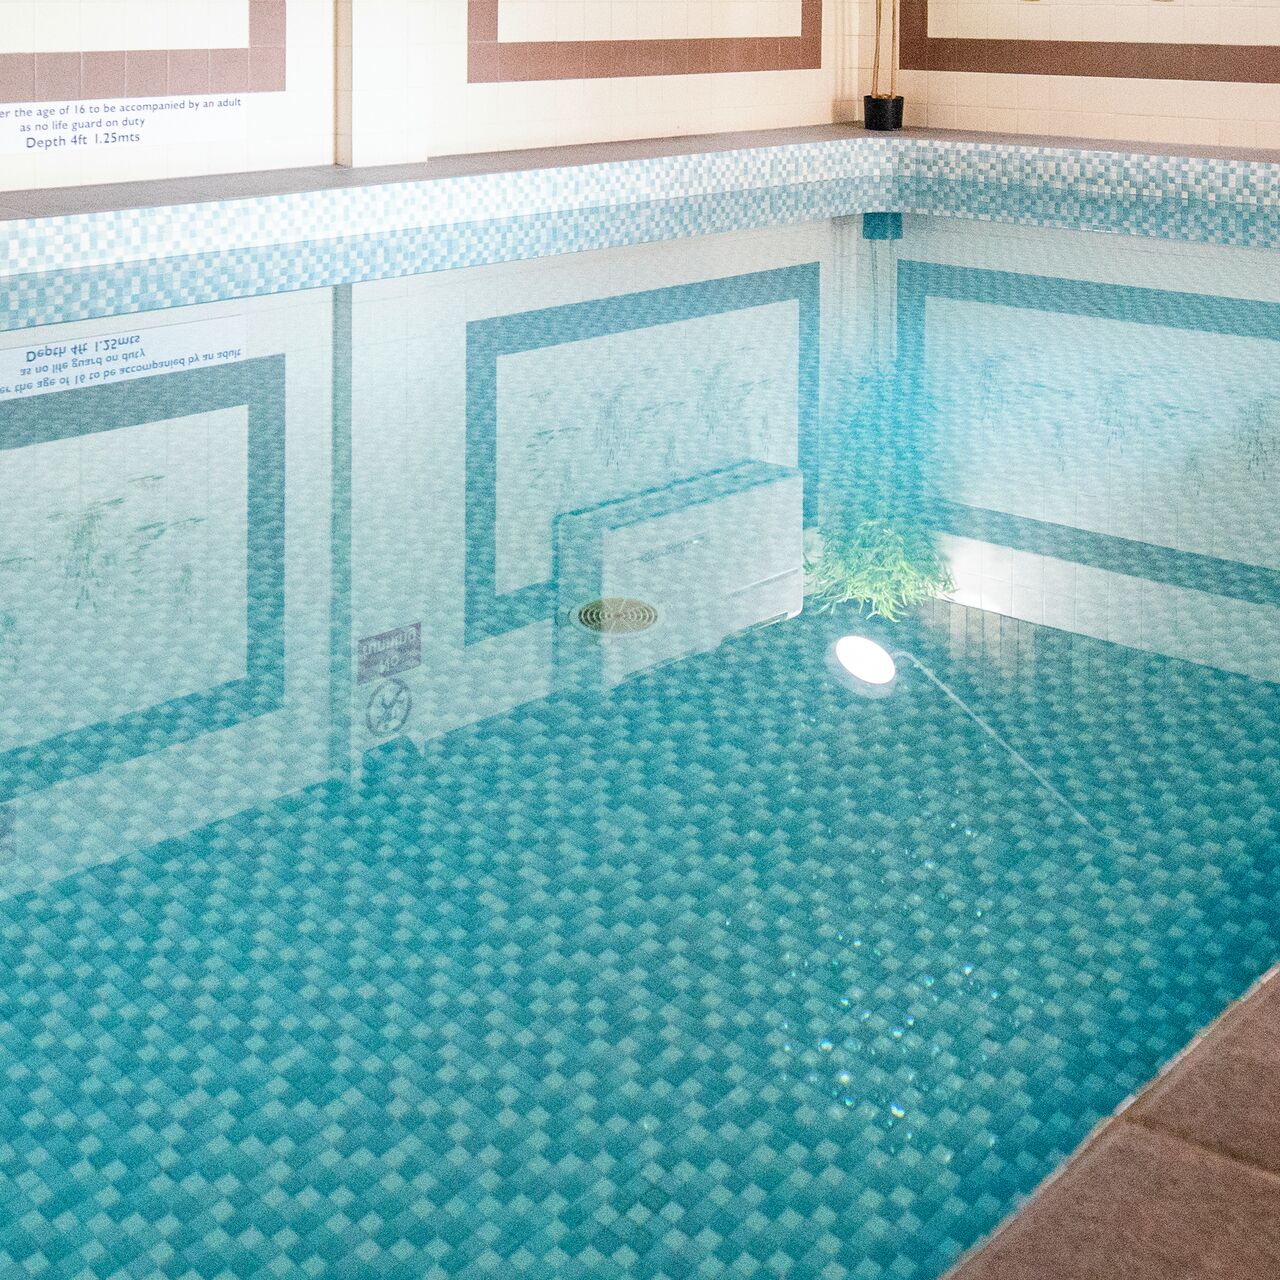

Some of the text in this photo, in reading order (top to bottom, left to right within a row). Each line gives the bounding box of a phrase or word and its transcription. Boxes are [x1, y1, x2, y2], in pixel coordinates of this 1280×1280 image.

[14, 106, 33, 118] the
[36, 108, 55, 119] age
[59, 104, 70, 115] of
[74, 104, 86, 115] 16
[89, 104, 100, 114] to
[103, 103, 116, 113] be
[119, 100, 185, 113] accompanied
[188, 99, 200, 111] by
[203, 99, 215, 108] an
[217, 98, 241, 108] adult
[19, 117, 146, 132] as no life guard on duty
[26, 132, 140, 150] Depth 4ft 1.25mts
